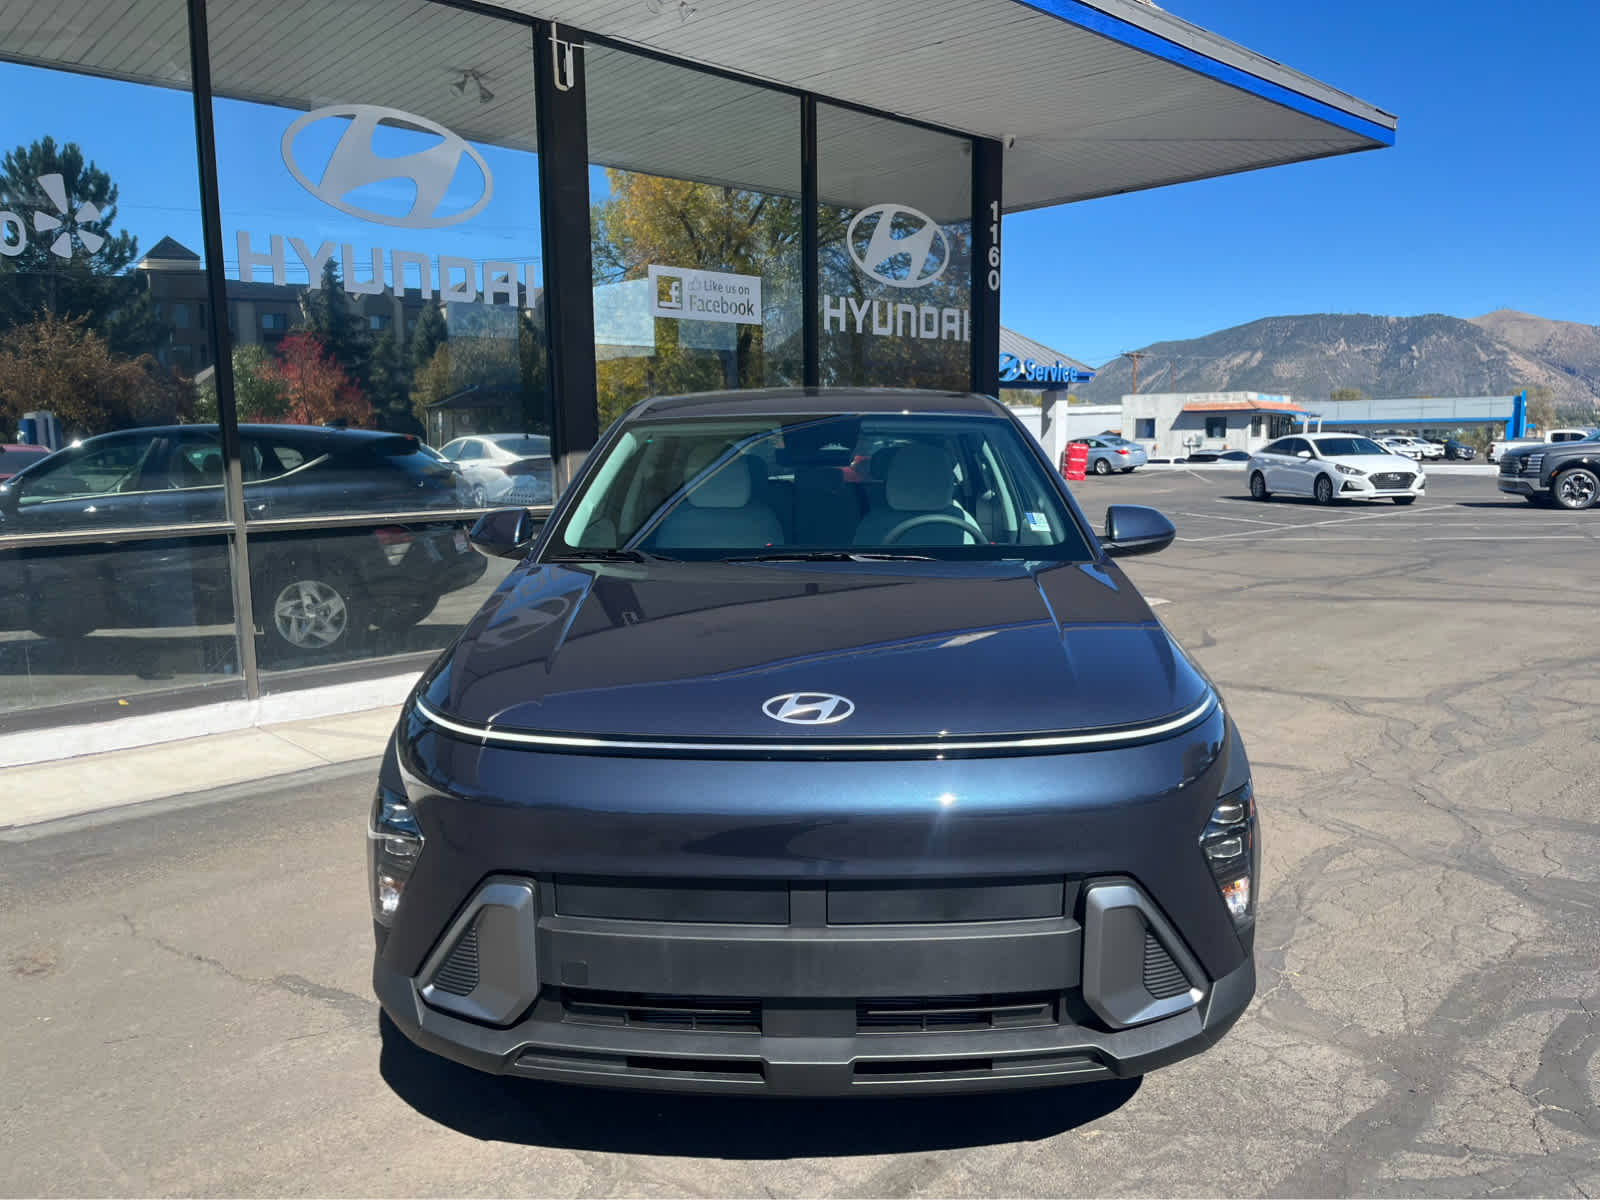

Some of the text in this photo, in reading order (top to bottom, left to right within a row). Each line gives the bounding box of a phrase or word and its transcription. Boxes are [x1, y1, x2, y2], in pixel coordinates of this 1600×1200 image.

[988, 200, 999, 291] 1160
[236, 230, 536, 308] HYUNDAI
[704, 279, 749, 295] Like us on
[688, 294, 755, 316] Facebook
[823, 294, 969, 341] HYUNDAI
[1024, 358, 1079, 383] Service
